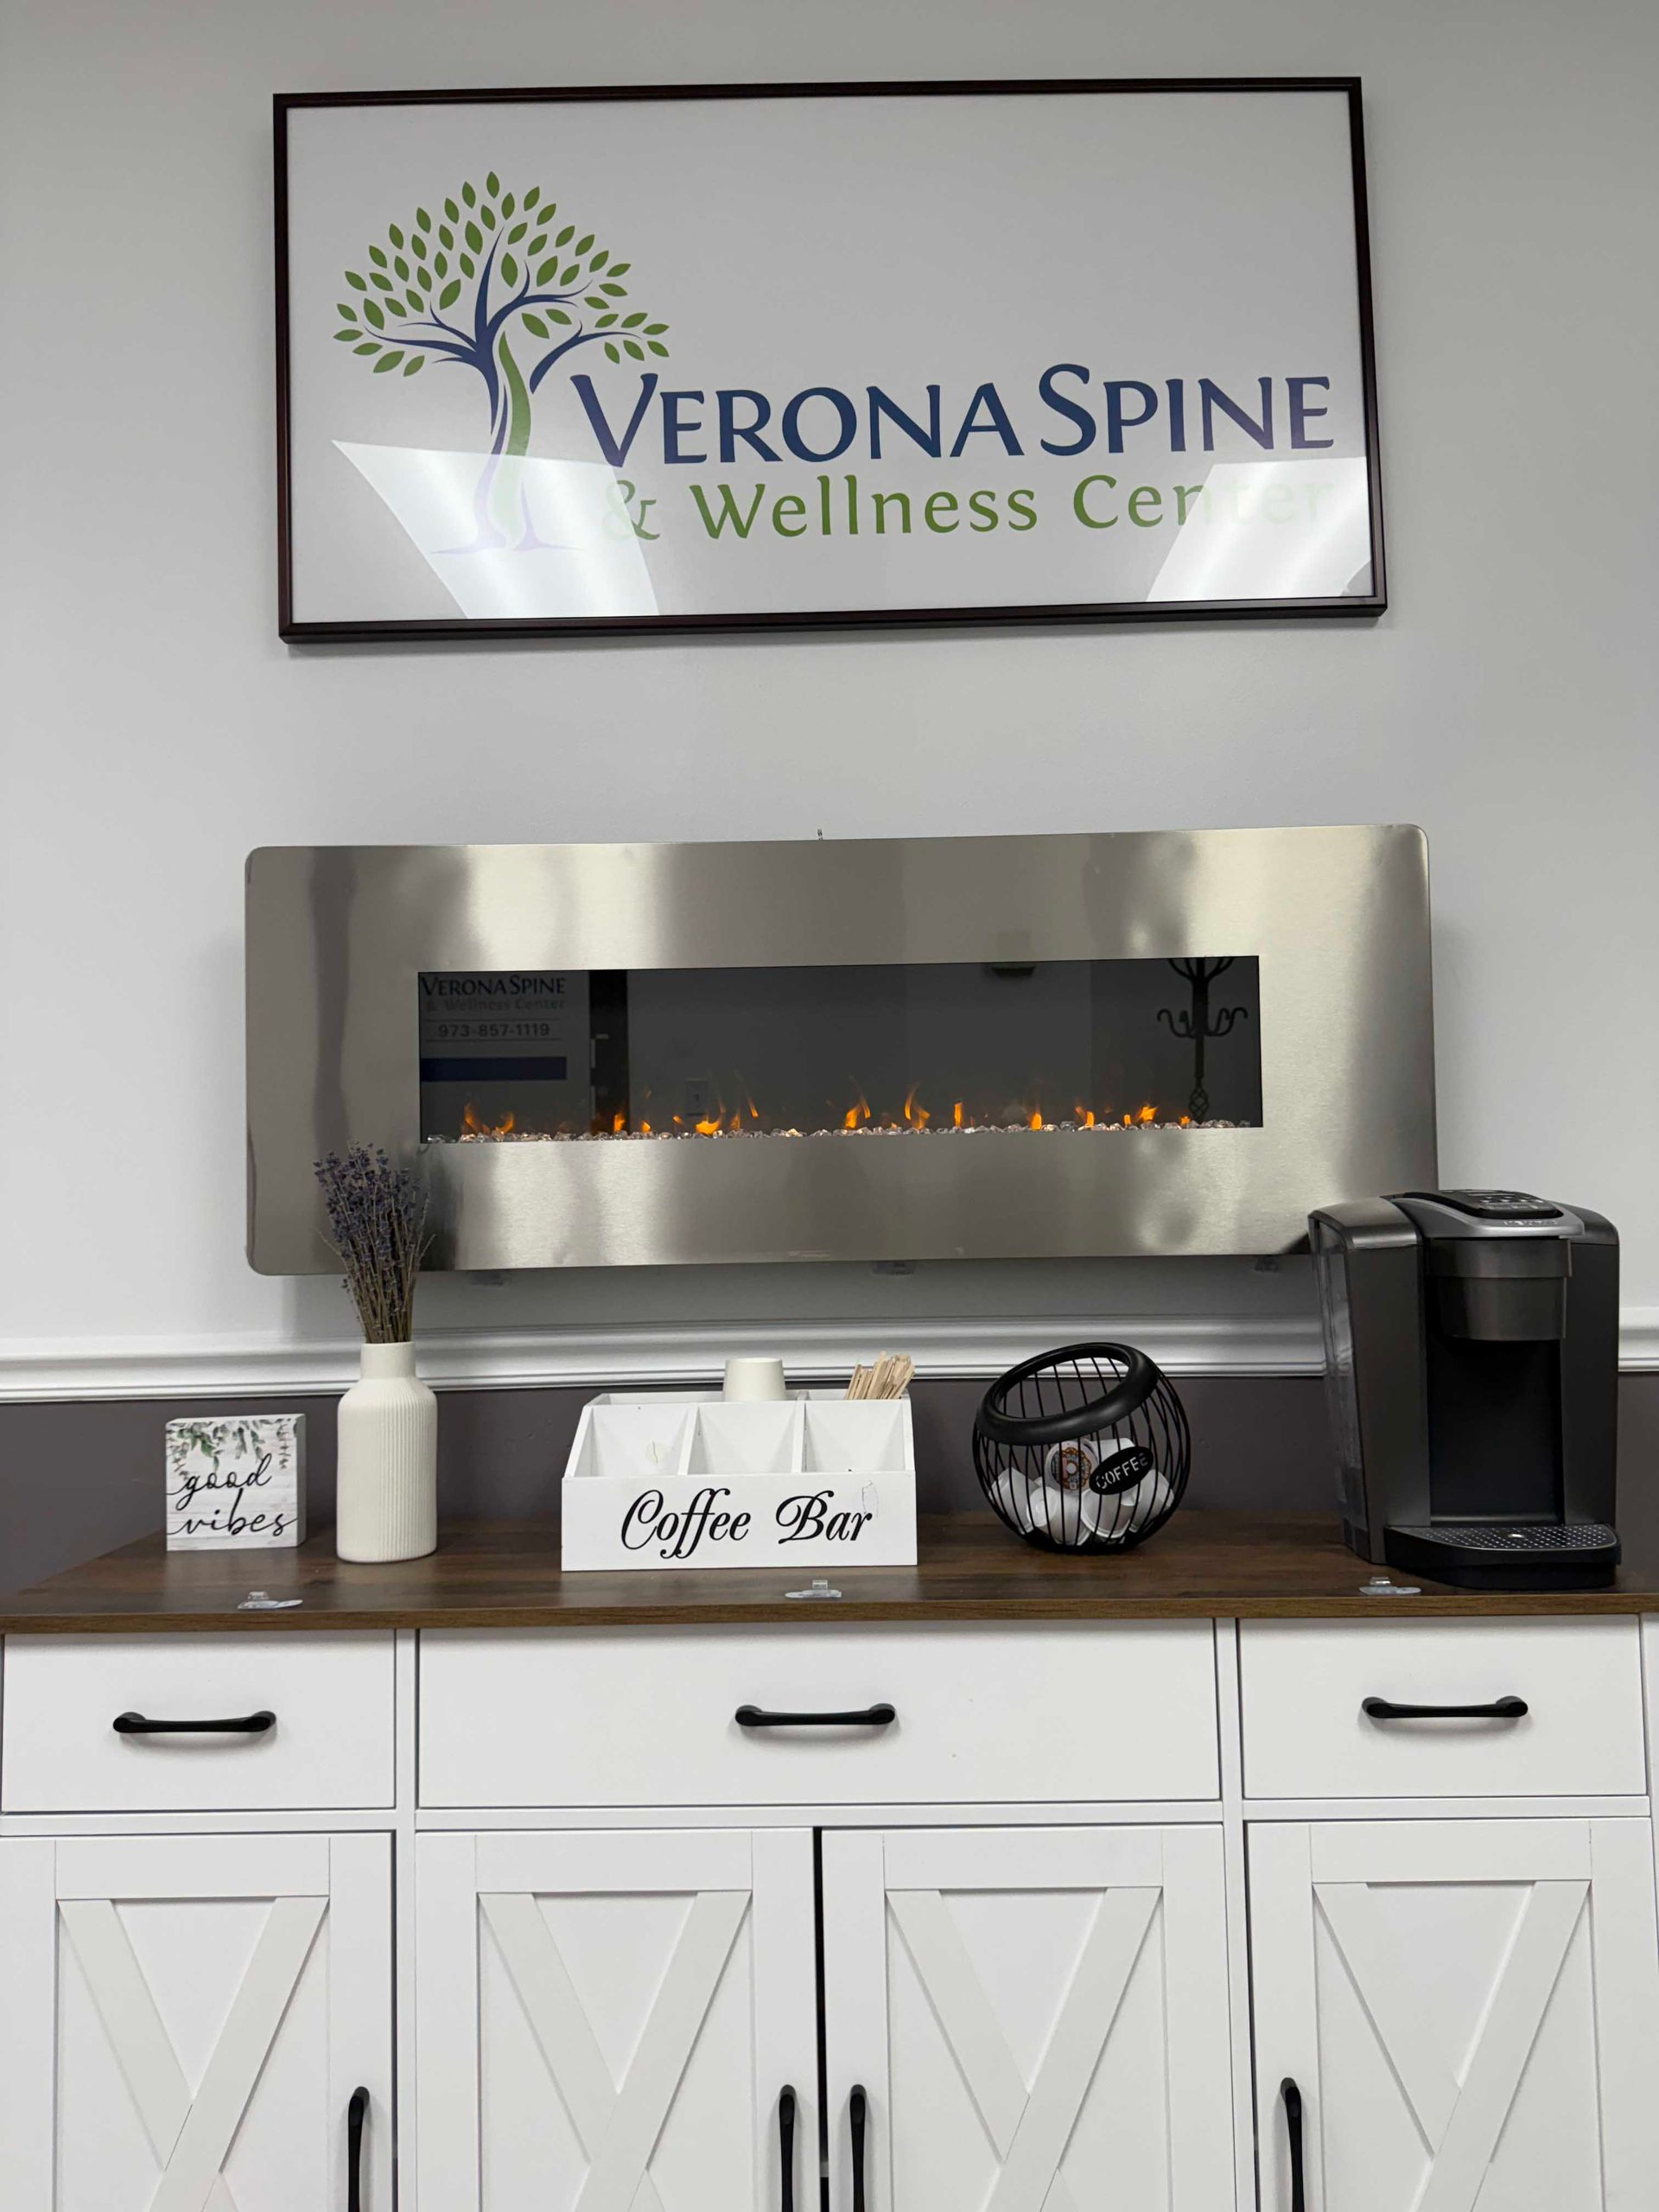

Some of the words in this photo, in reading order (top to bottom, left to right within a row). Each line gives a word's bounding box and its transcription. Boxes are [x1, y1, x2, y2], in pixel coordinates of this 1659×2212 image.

[569, 373, 1025, 468] VERONA
[1039, 363, 1335, 457] SPINE
[601, 480, 661, 541] &
[689, 474, 1038, 541] Wellness
[1072, 474, 1335, 531] Center
[421, 976, 506, 995] VERONA
[510, 975, 567, 995] SPINE
[444, 998, 511, 1011] Wellness
[515, 998, 565, 1010] Center
[437, 1022, 550, 1038] 973-857-1119
[166, 1452, 273, 1511] good
[1095, 1452, 1148, 1490] COFFEE
[167, 1487, 298, 1536] vibes
[620, 1488, 752, 1560] Coffee
[775, 1490, 873, 1545] Bar
